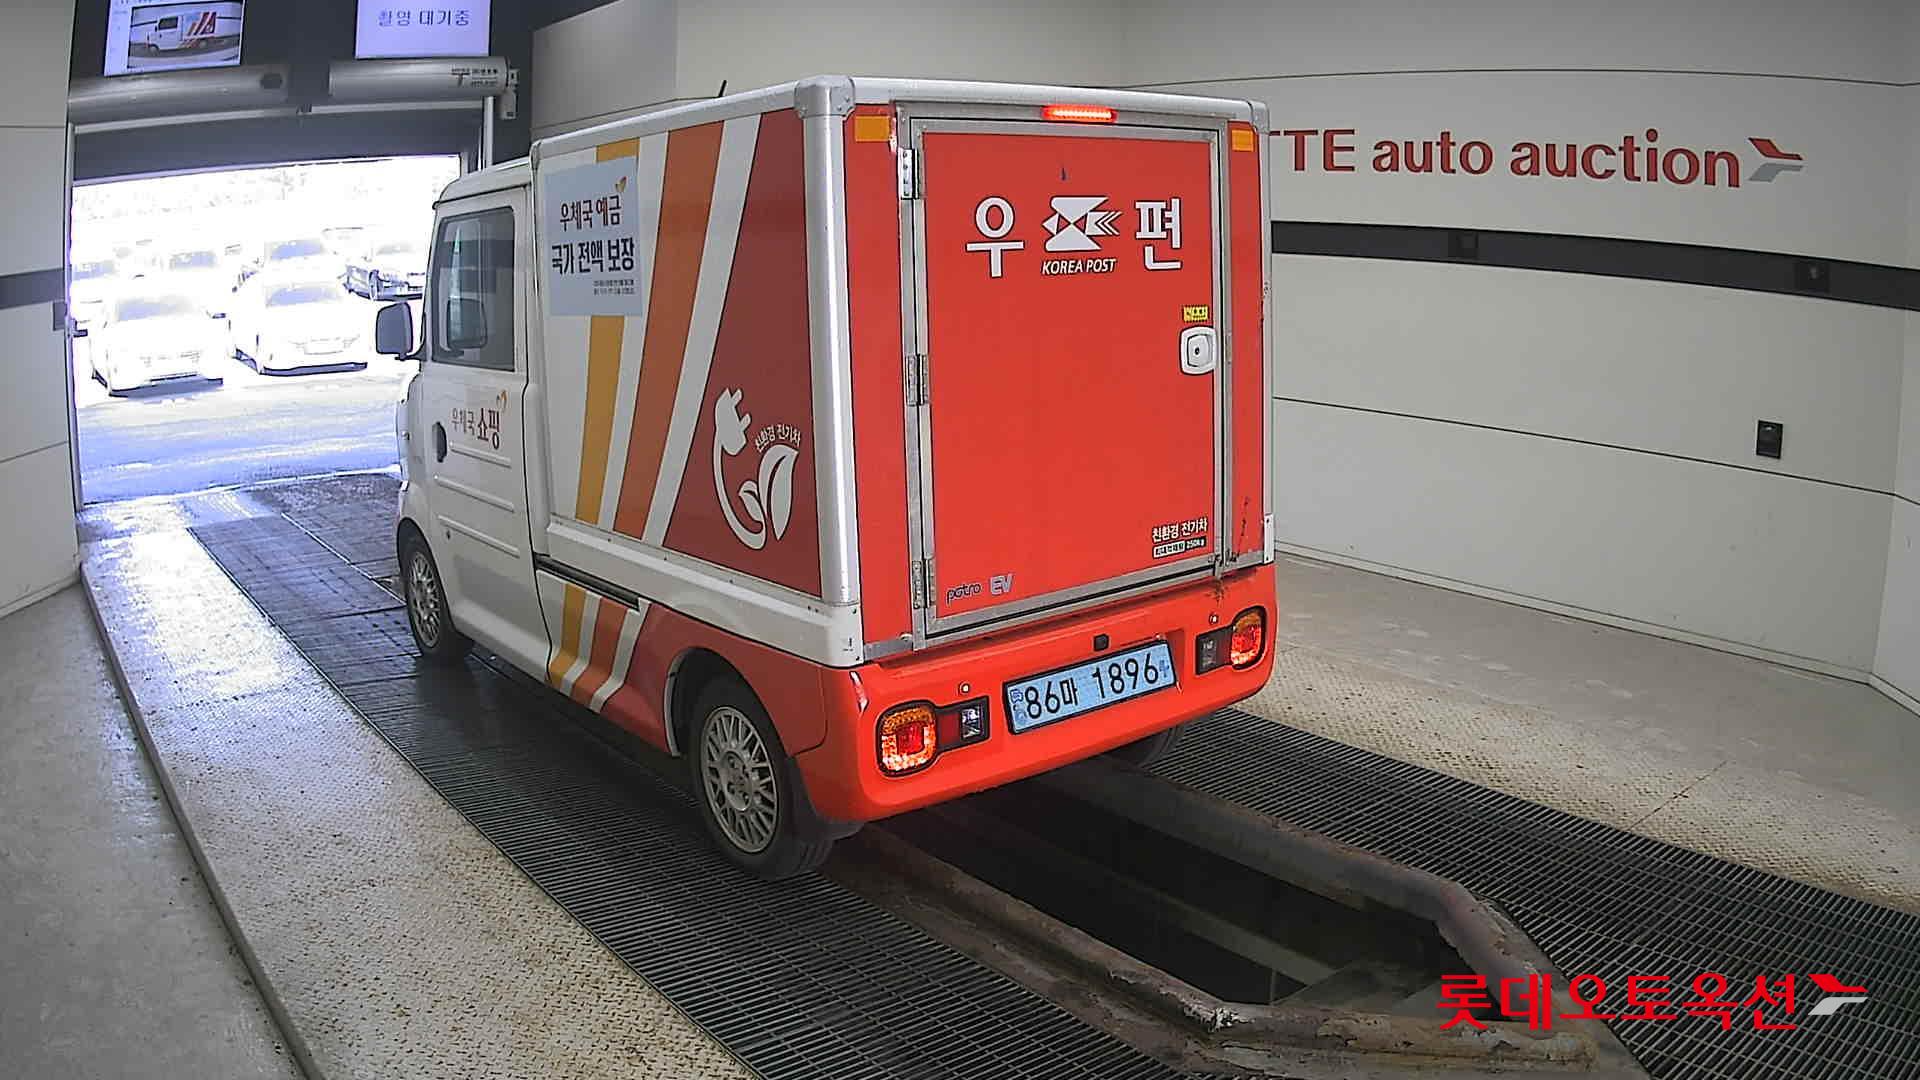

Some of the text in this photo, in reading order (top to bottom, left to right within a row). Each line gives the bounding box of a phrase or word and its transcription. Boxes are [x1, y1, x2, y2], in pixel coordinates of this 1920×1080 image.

[419, 9, 470, 27] 대기중
[1269, 129, 1741, 188] TE auto auction
[560, 194, 622, 233] 우체국 예금
[966, 196, 1182, 278] 우 편
[552, 236, 635, 275] 국가 전액 보장
[1041, 257, 1117, 276] KOREA POST
[755, 423, 801, 453] 친환경 전기차
[1152, 517, 1208, 543] 친환경 전기차
[990, 574, 1013, 594] EV
[1024, 652, 1160, 720] 86마 1896
